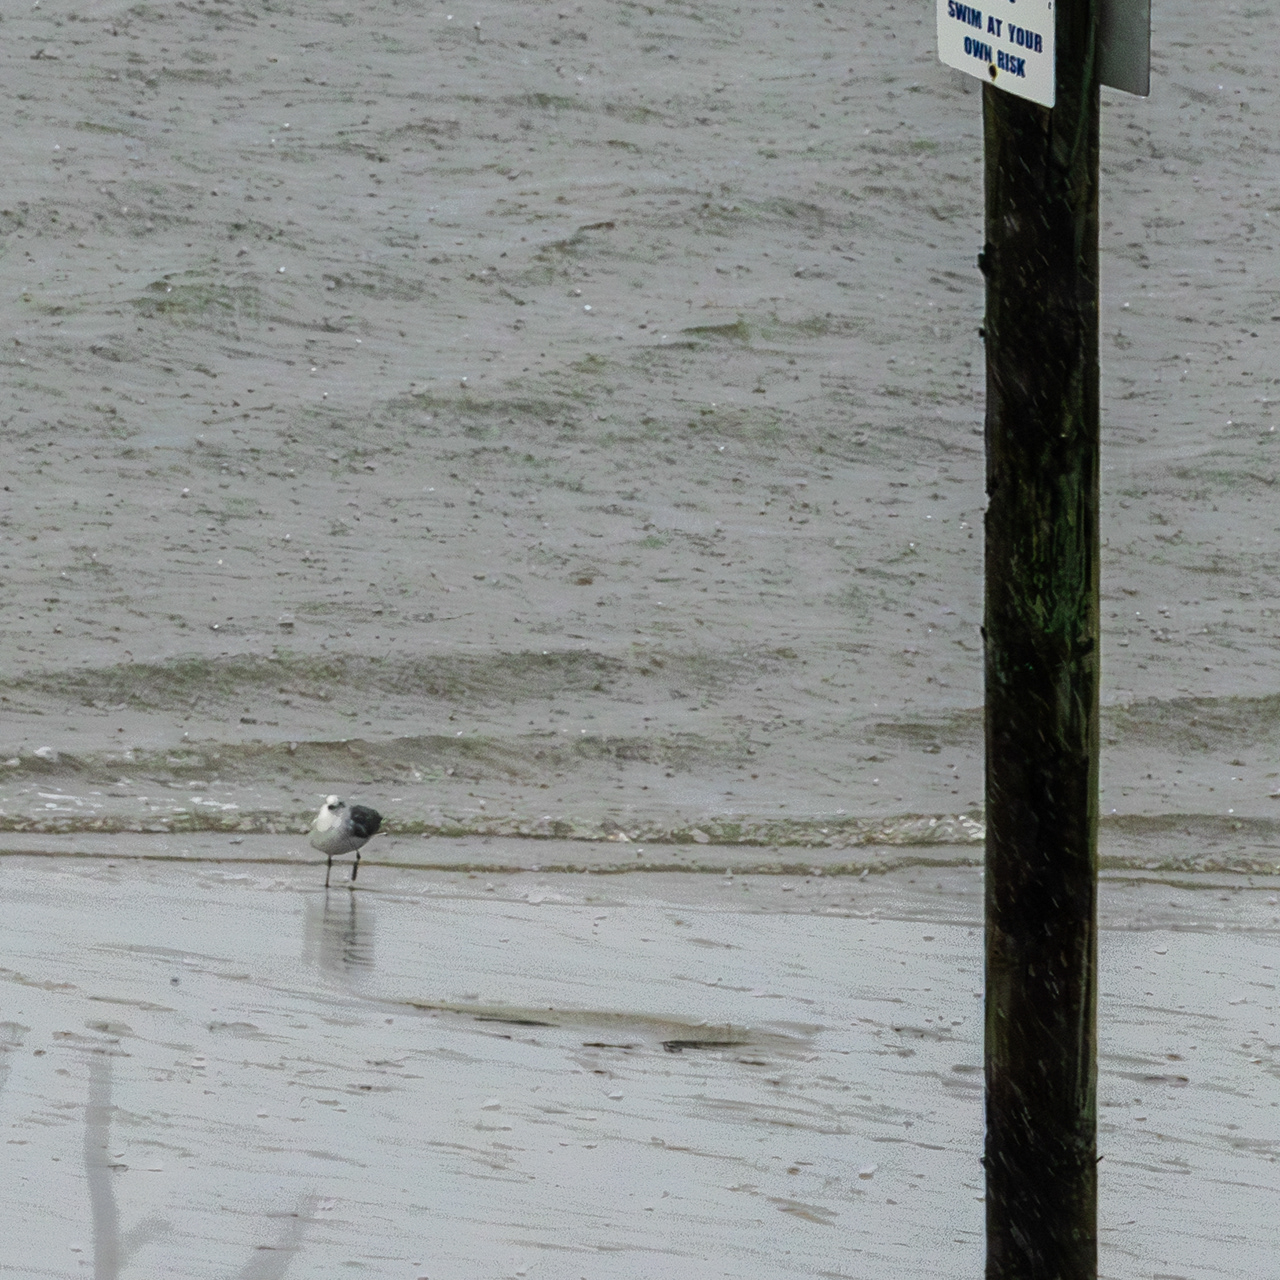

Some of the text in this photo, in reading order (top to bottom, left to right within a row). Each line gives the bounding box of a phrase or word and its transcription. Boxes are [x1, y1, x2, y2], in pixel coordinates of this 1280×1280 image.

[947, 0, 1043, 54] SWIM AT YOUR
[963, 35, 1026, 79] OWN RISK
